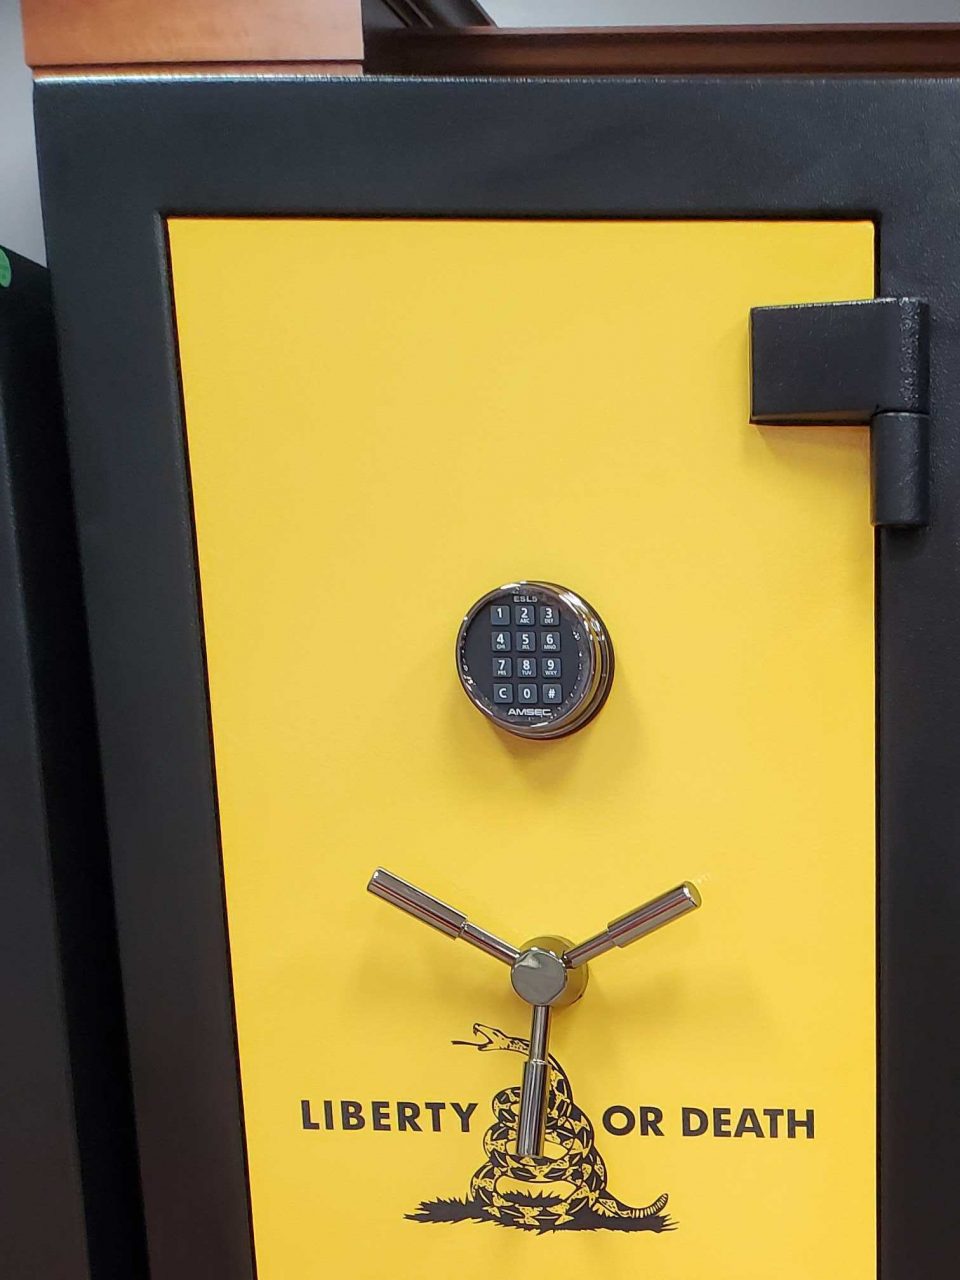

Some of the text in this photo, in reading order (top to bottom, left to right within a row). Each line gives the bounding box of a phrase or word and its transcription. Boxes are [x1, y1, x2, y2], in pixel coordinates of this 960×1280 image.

[497, 608, 552, 618] 1 2 3
[496, 634, 553, 644] 4 5 6
[498, 660, 554, 670] 7 8 9
[499, 688, 556, 698] C 0 #
[301, 1100, 815, 1139] LIBERTY OR DEATH
